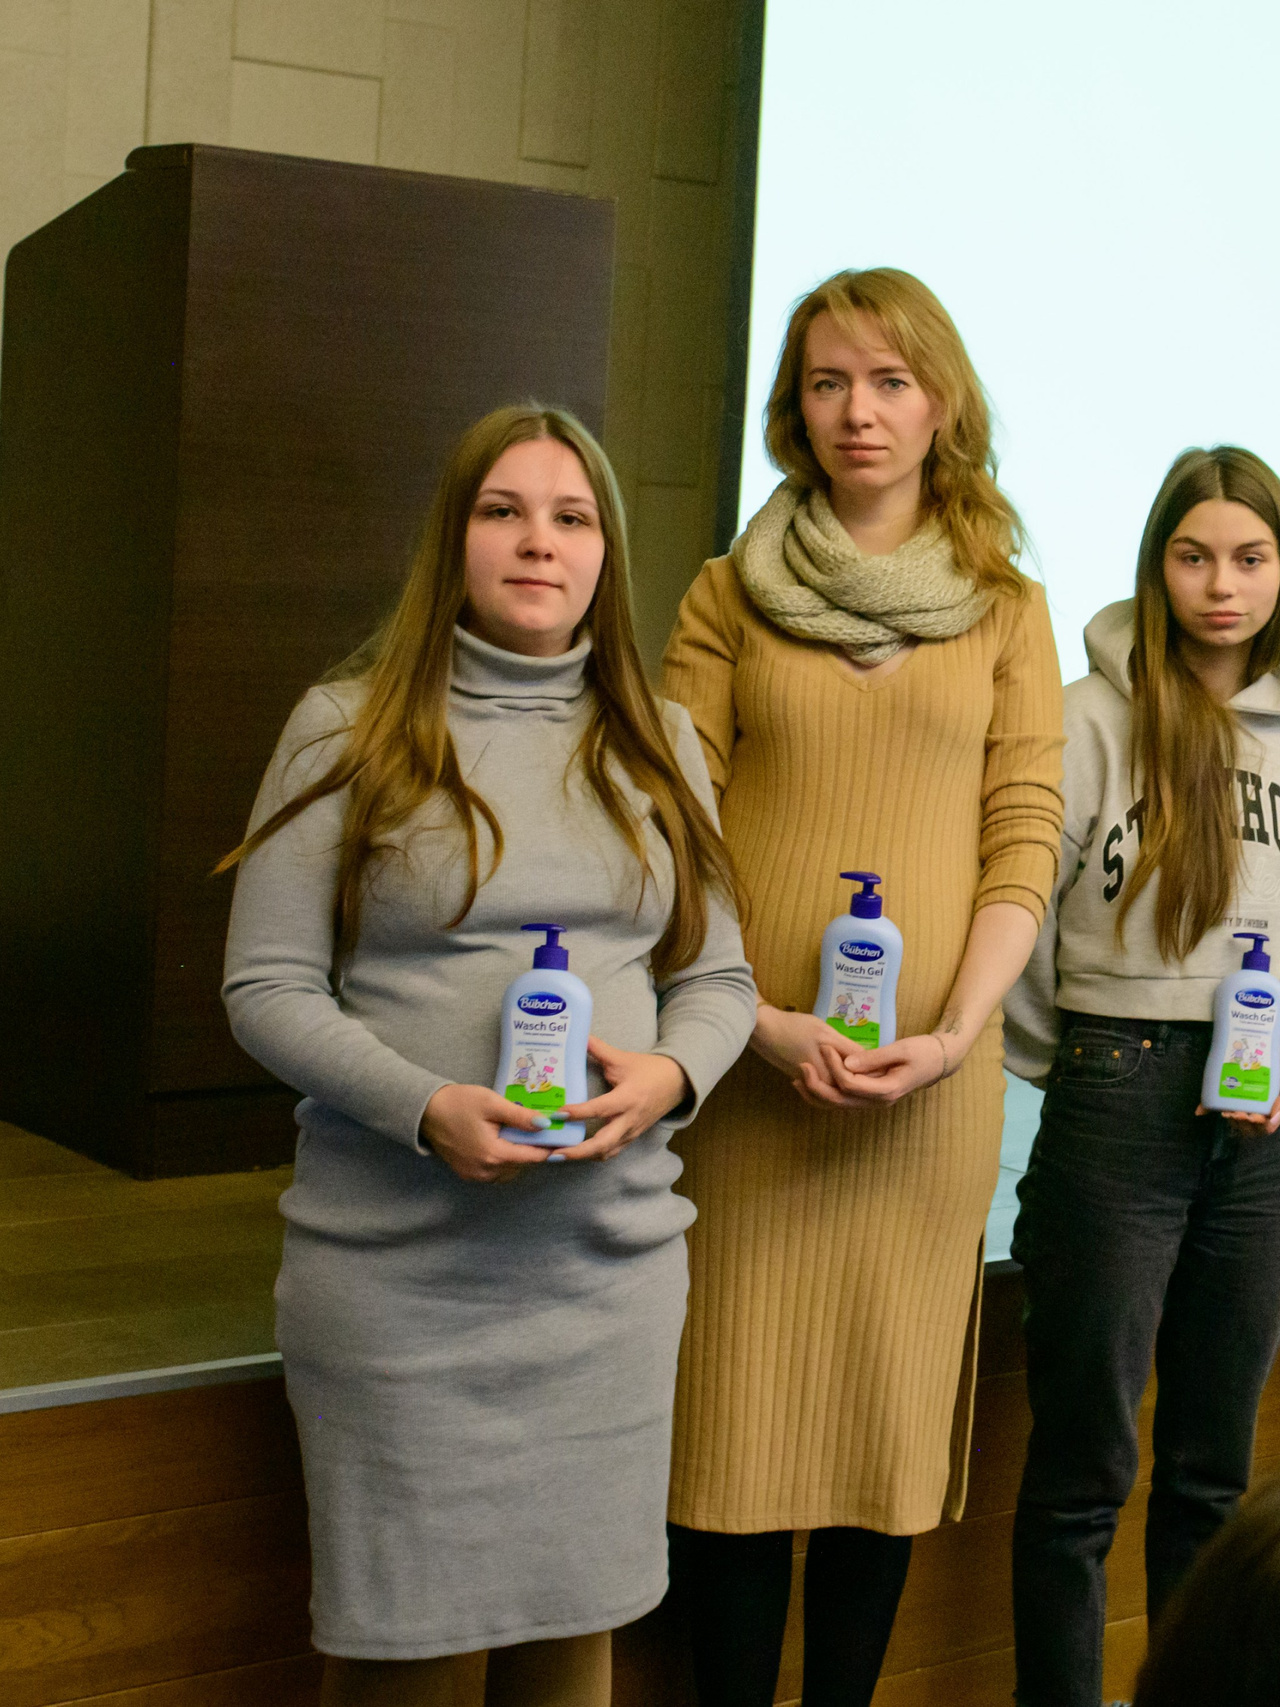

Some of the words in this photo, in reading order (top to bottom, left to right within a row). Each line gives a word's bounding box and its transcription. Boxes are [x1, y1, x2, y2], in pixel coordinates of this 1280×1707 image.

[841, 943, 881, 958] Bübchen
[835, 961, 866, 975] Wasch
[867, 966, 884, 976] Gel
[520, 997, 564, 1010] Bübchen
[1231, 1010, 1259, 1021] Wasch
[1260, 1013, 1275, 1023] Gel
[513, 1020, 547, 1031] Wasch
[549, 1021, 567, 1032] Gel
